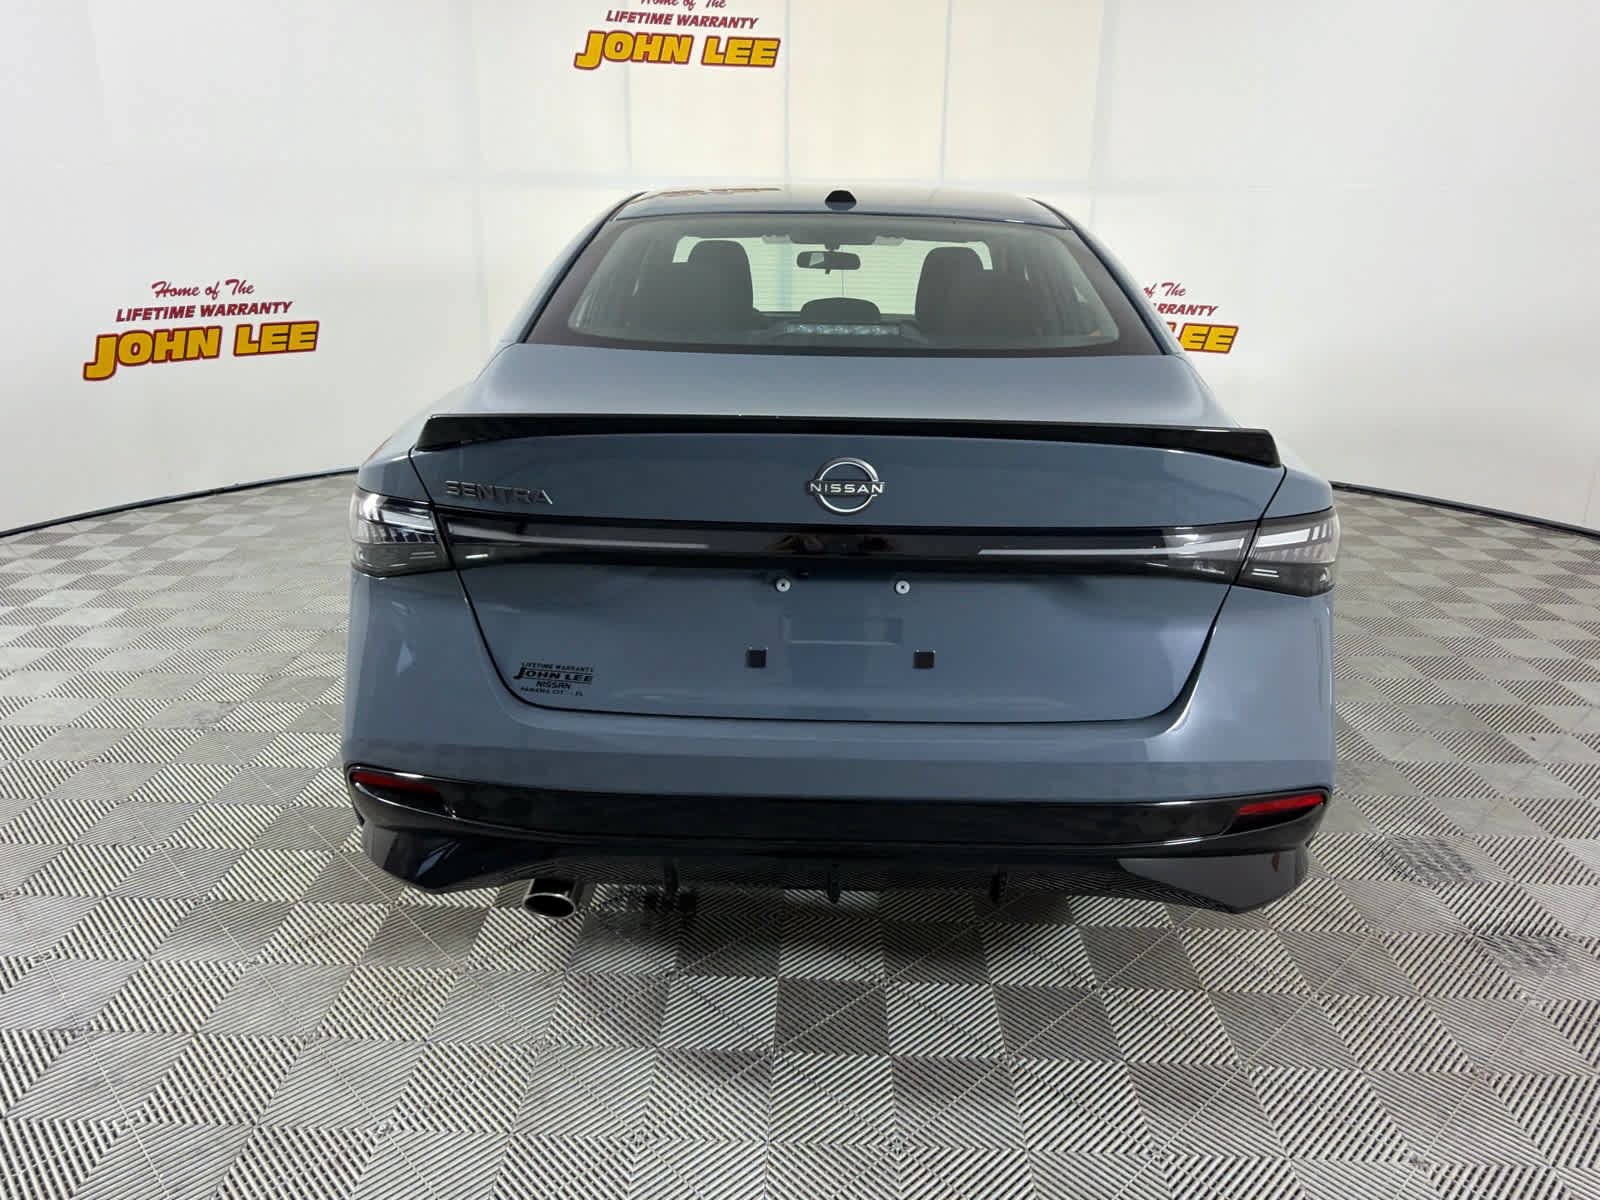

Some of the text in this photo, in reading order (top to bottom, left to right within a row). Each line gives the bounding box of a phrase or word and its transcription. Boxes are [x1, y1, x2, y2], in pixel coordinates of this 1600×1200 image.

[606, 10, 758, 29] LIFETIME WARRANTY
[573, 30, 780, 70] JOHN LEE
[152, 278, 255, 300] Home of The
[1161, 282, 1186, 296] The
[116, 301, 293, 322] LIFETIME WARRANTY
[1153, 303, 1218, 316] RRANTY
[1166, 322, 1239, 354] EE
[83, 320, 320, 381] JOHN LEE
[445, 480, 553, 505] SENTRA
[809, 483, 883, 493] NISSAN
[513, 667, 593, 682] JOHN LEE
